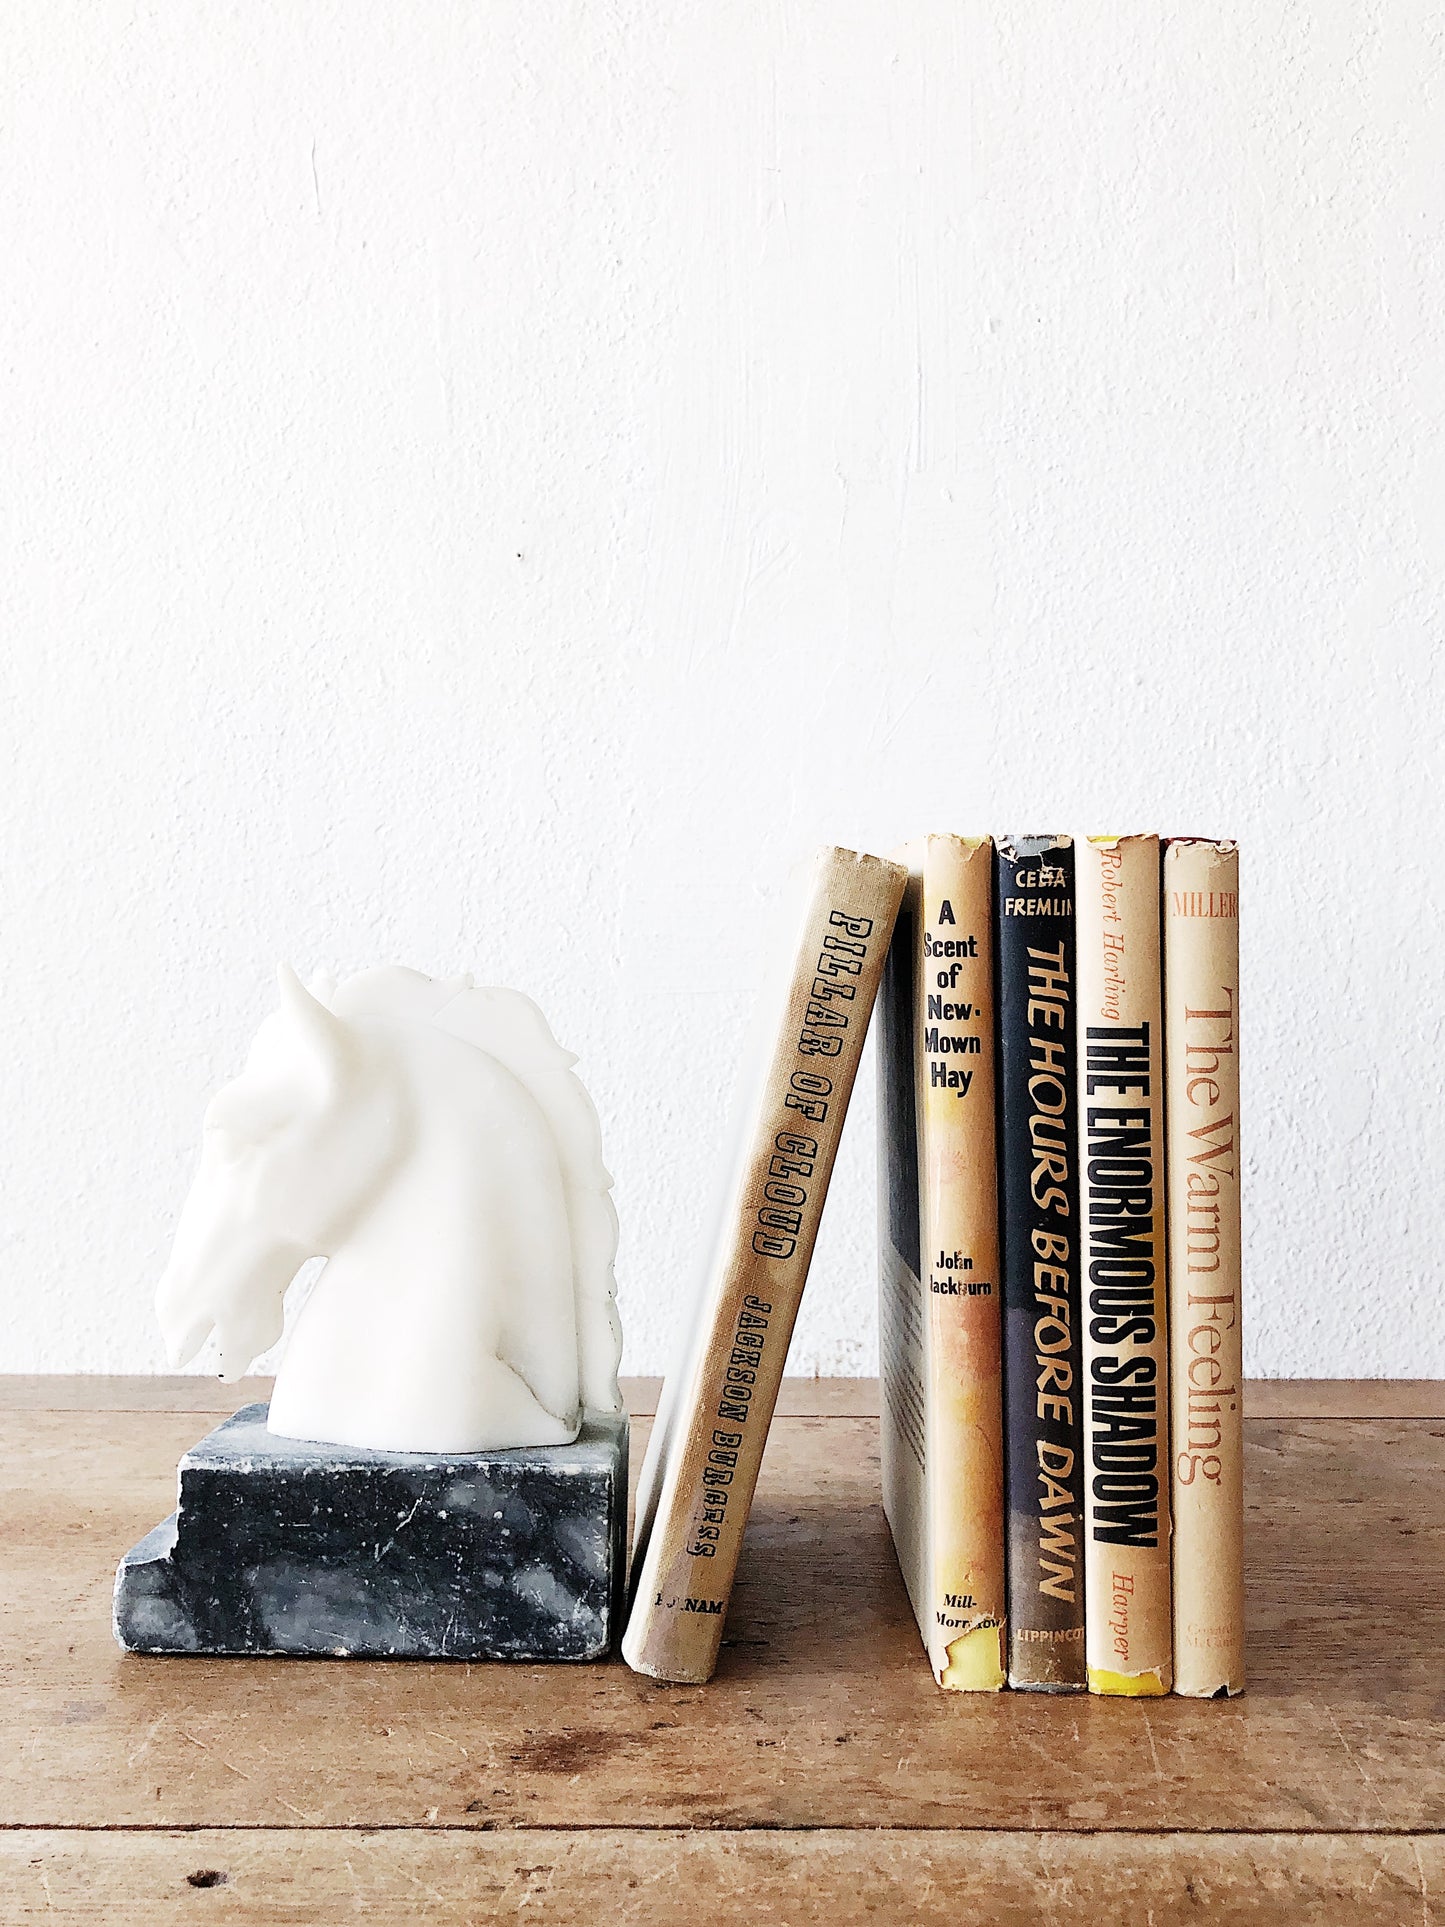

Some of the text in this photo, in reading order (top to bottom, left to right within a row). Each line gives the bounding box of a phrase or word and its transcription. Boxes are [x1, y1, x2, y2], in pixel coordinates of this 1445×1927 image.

[938, 899, 956, 925] A
[1172, 891, 1237, 918] MILLER
[924, 932, 979, 958] Scent
[1100, 850, 1126, 1021] Robert Harling
[937, 962, 962, 989] of
[924, 1027, 981, 1053] Mown
[752, 910, 874, 1260] PILLAR OF CLOUD
[930, 1062, 973, 1098] Hay
[1177, 985, 1236, 1487] The Warm Feeling
[936, 1250, 973, 1270] John
[1026, 940, 1077, 1604] THE HOURS BEFORE DAWN
[1086, 1021, 1160, 1548] THE ENORMOUS SHADOW
[686, 1295, 772, 1558] JACKSON BURGESS
[655, 1593, 724, 1614] NAM
[942, 1593, 978, 1609] Mill-
[1112, 1570, 1135, 1662] Harper
